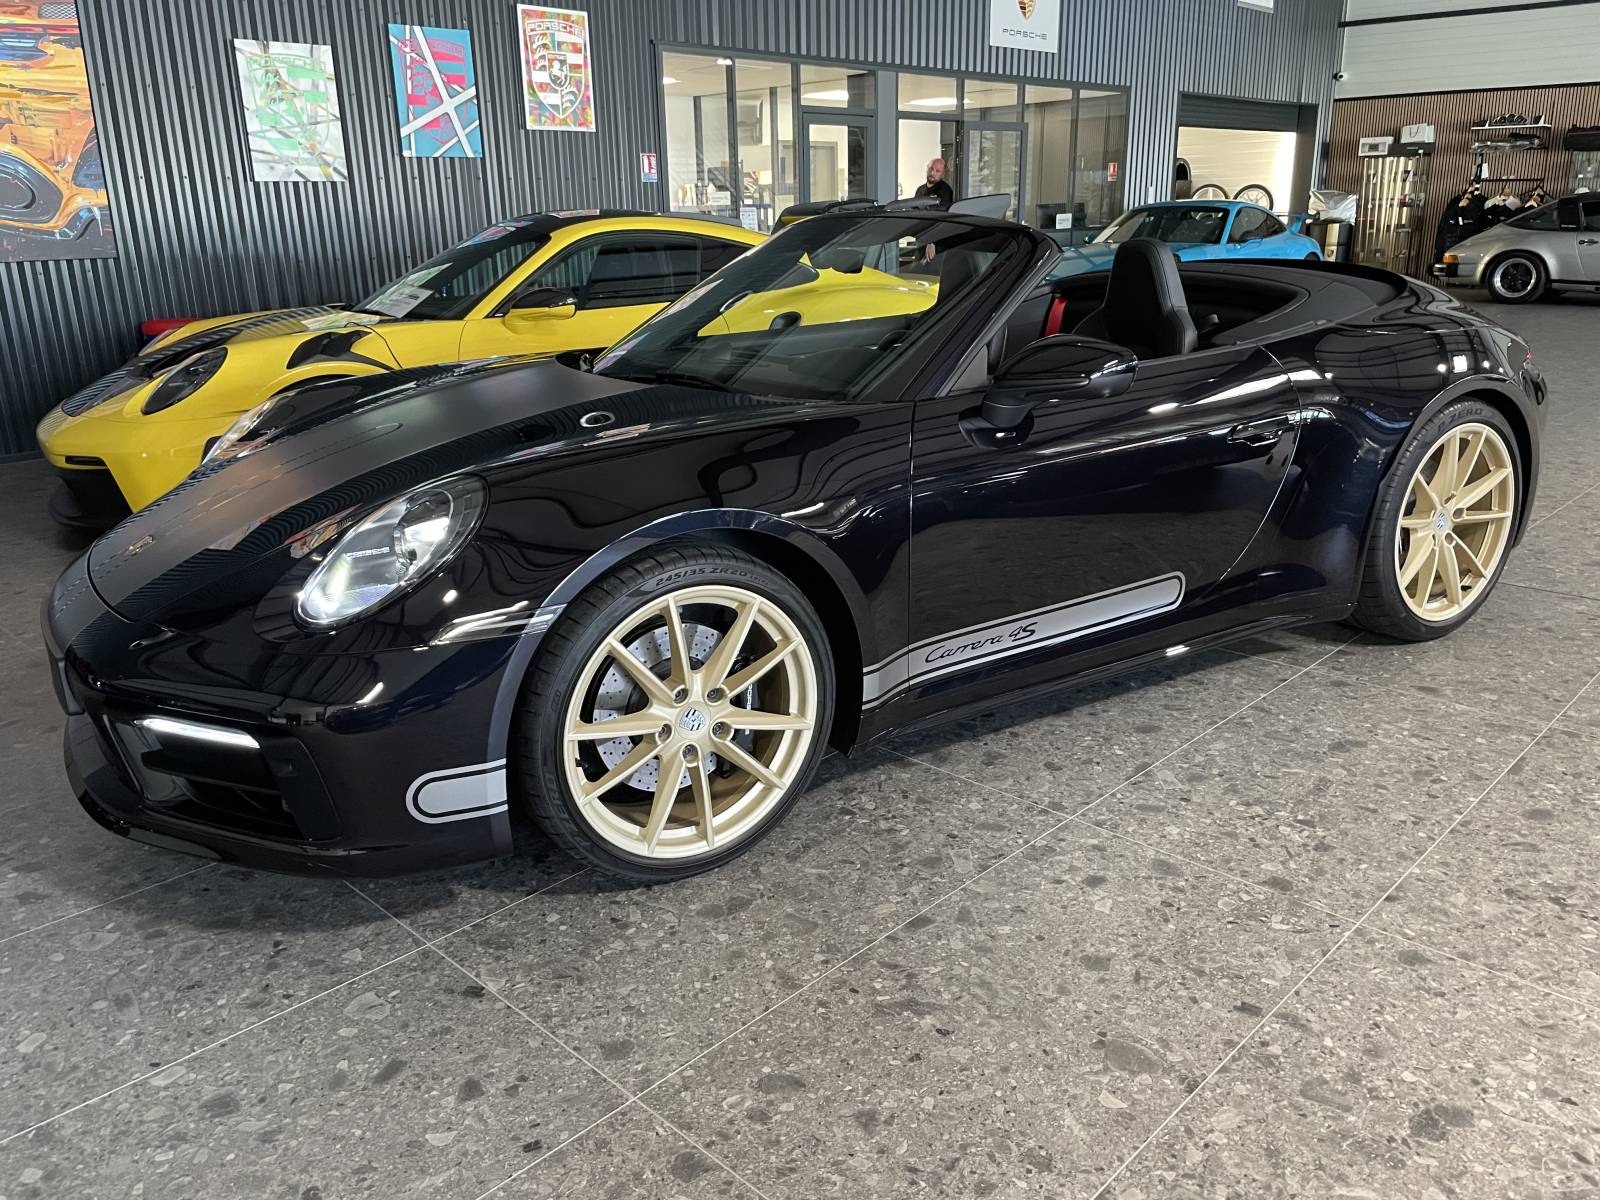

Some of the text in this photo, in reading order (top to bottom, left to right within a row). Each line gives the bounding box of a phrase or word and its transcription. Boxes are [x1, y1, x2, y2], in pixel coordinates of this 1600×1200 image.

[527, 23, 583, 38] PORSCHE
[1002, 28, 1047, 40] PORSCHE
[1448, 408, 1483, 425] ZERO
[655, 567, 748, 587] 245/35 ZR20
[925, 622, 1039, 663] Carrera 4S
